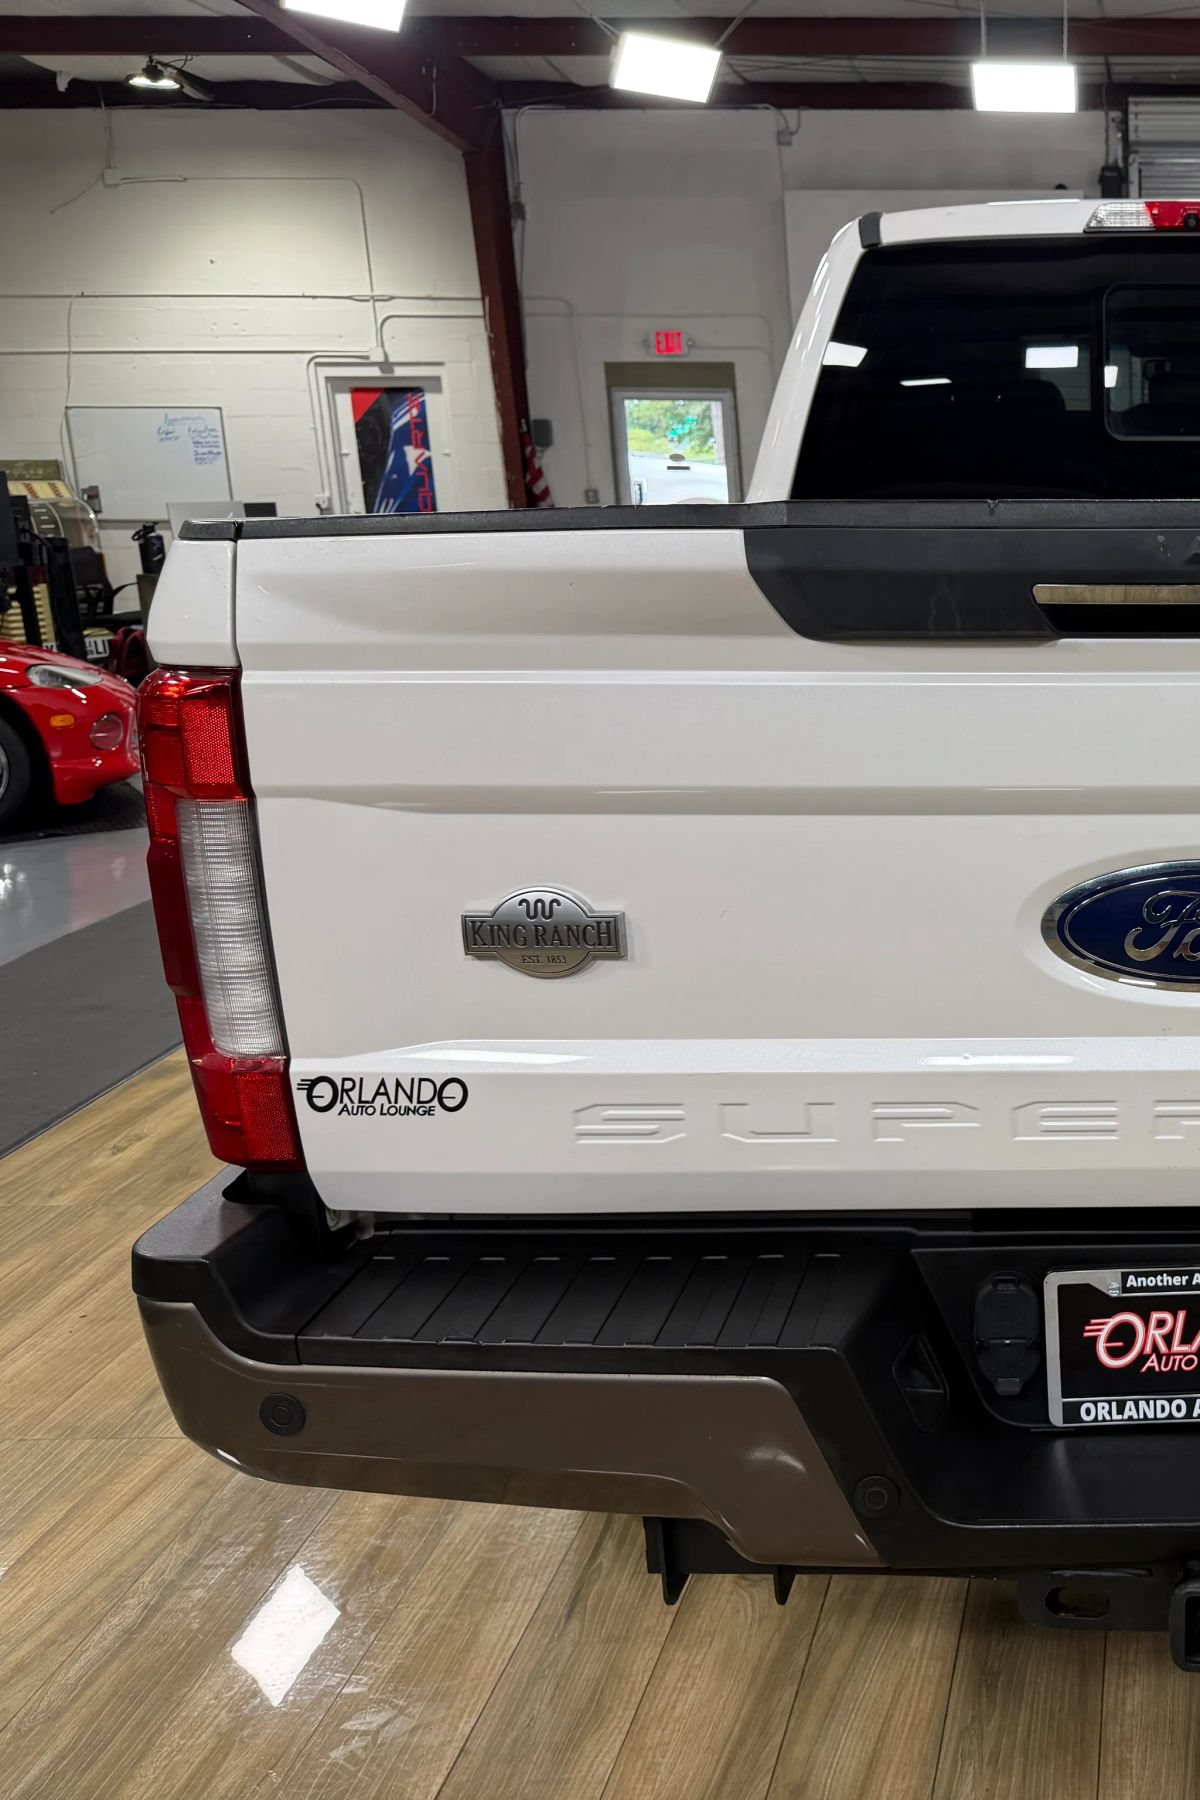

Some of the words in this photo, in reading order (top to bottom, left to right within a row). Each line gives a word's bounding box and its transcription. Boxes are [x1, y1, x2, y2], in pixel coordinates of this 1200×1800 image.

[470, 920, 528, 947] KING
[534, 920, 614, 948] RANCH
[521, 955, 544, 965] EST.
[546, 955, 567, 964] 1853
[297, 1075, 469, 1113] ORLANDO
[1126, 1273, 1189, 1289] Another
[1079, 1400, 1187, 1422] ORLANDO
